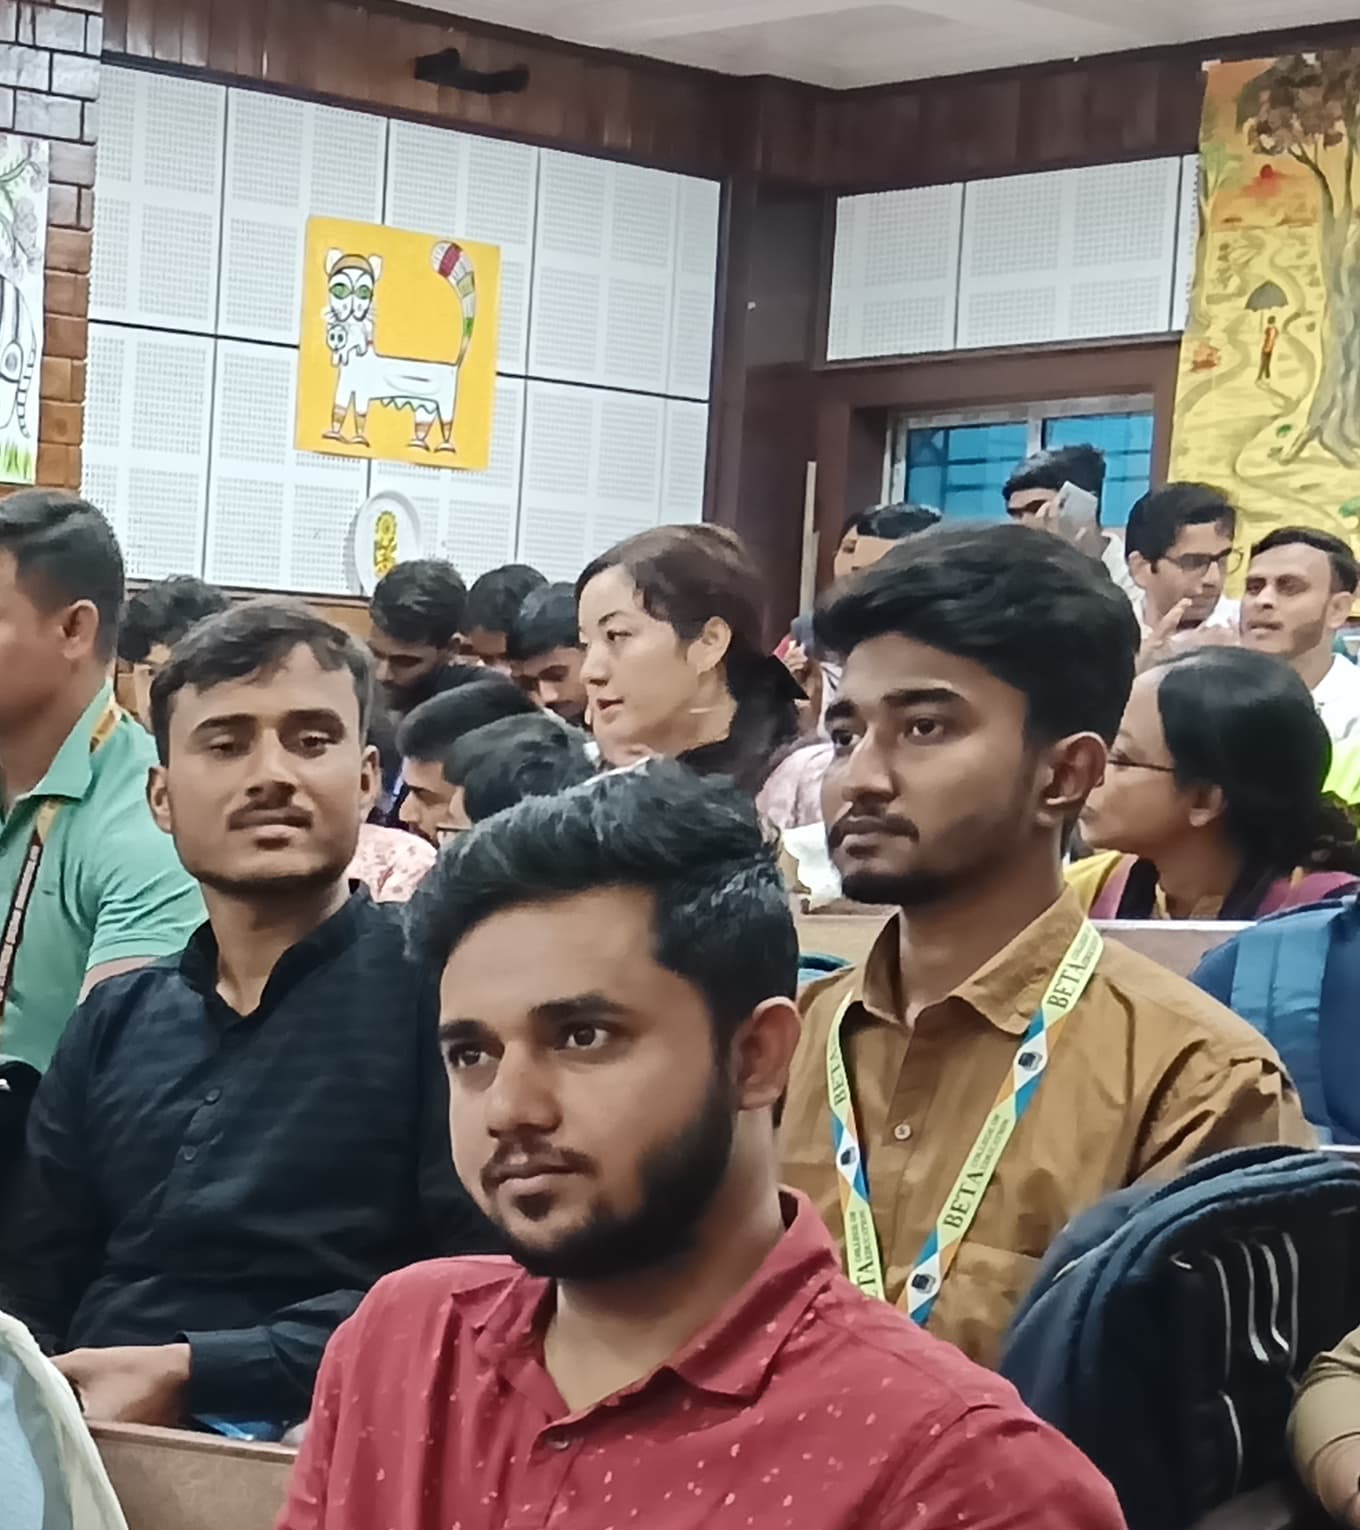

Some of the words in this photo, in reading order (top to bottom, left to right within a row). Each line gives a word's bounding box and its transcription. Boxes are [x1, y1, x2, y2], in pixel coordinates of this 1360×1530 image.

[1046, 963, 1087, 1010] BETA
[829, 1046, 848, 1107] BETA
[942, 1171, 984, 1229] BETA
